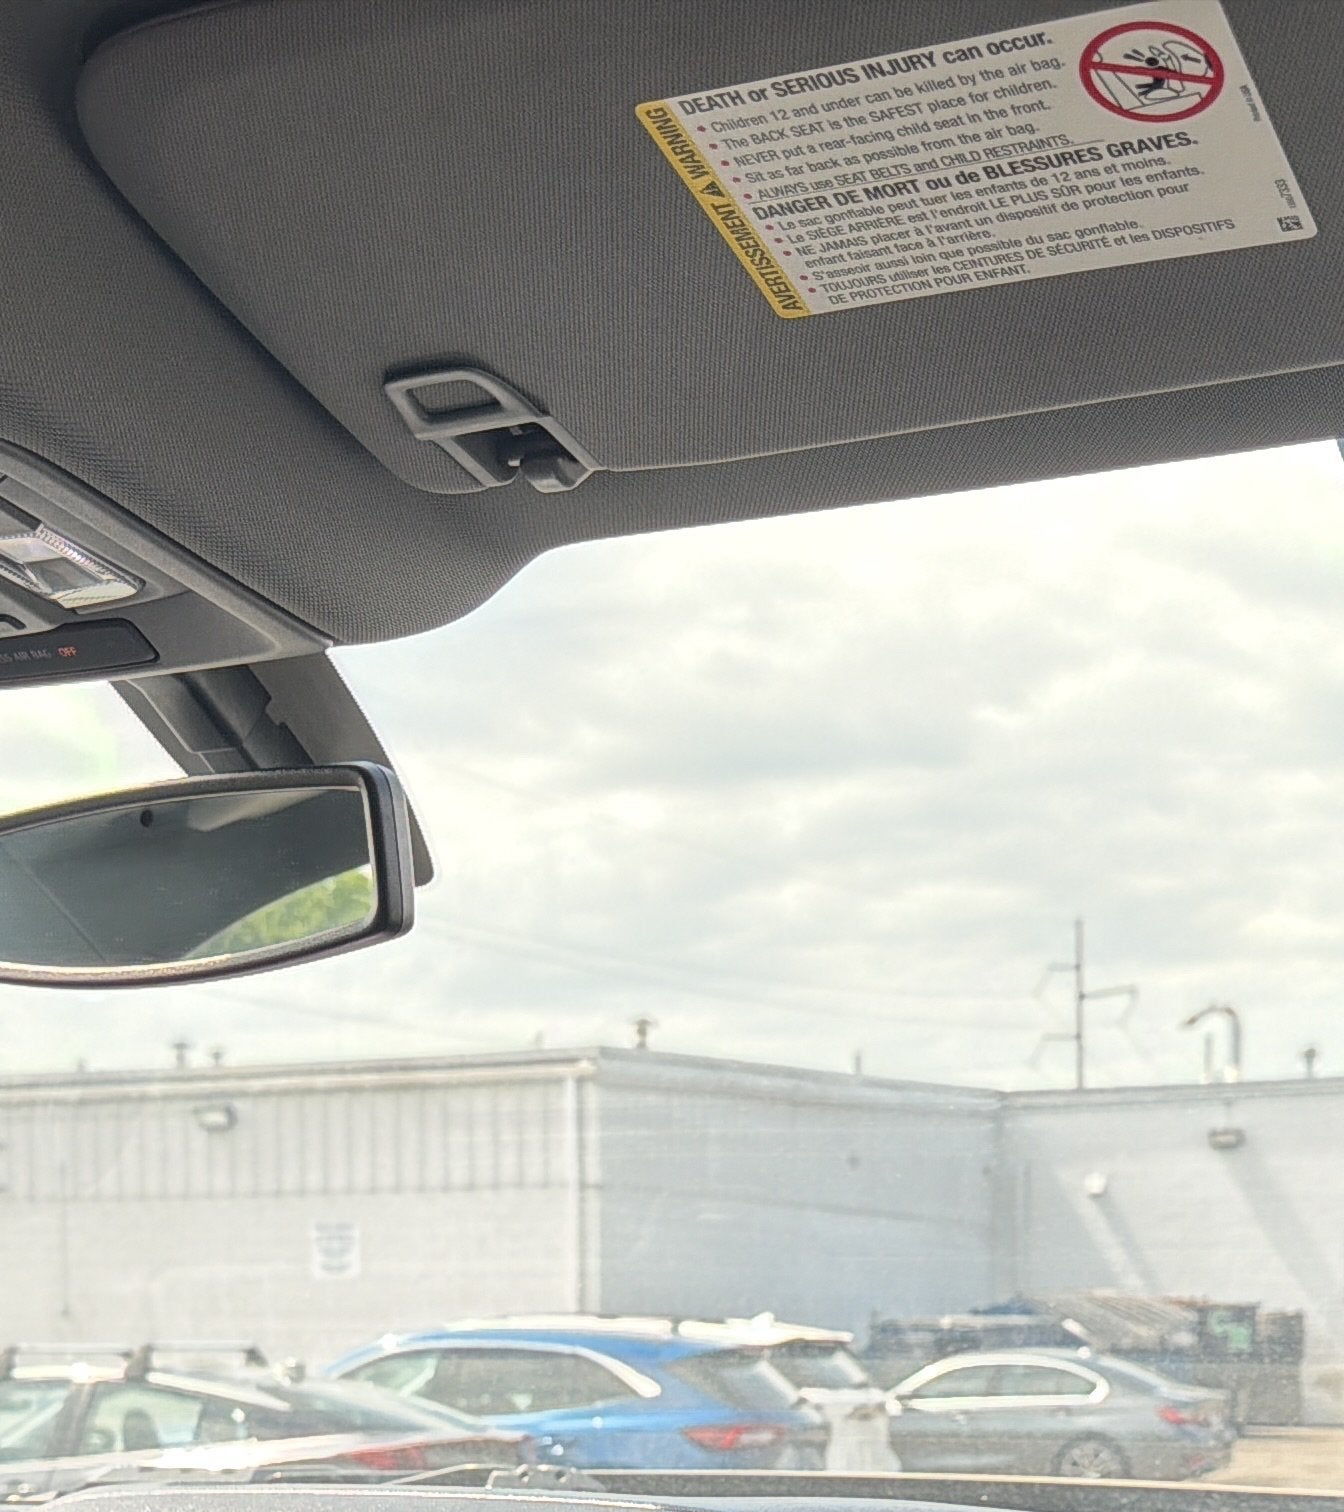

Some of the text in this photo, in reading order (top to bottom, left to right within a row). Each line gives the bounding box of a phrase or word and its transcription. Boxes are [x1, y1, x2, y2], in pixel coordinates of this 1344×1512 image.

[678, 32, 1052, 115] DEATH or SERIOUS INJURY can occur.
[710, 57, 1065, 132] Children 12 and under can be killed by the air bag.
[719, 80, 1056, 150] The BACK SEAT is the SAFEST place for children.
[733, 149, 781, 167] NEVER
[780, 144, 806, 160] put
[818, 130, 895, 151] rear-facing
[896, 120, 931, 137] child
[933, 114, 965, 130] seat
[965, 112, 982, 123] in
[982, 108, 1008, 120] the
[1010, 99, 1051, 115] front.
[744, 123, 1039, 183] Sit as far back as possible from the air bag.
[752, 131, 1197, 220] DANGER DE MORT ou de BLESSURES GRAVES.
[757, 134, 1075, 200] ALWAYS use SEAT BELTS and CHILD RESTRAINTS.
[645, 106, 803, 310] AVERTISSEMENT WARNING
[776, 221, 796, 231] Le
[797, 216, 822, 227] sac
[886, 198, 919, 214] peut
[919, 194, 947, 206] tuer
[949, 190, 973, 201] les
[975, 180, 1027, 196] enfants
[1029, 176, 1048, 187] de
[1051, 171, 1071, 183] 12
[1073, 167, 1101, 180] ans
[1103, 162, 1120, 174] et
[1120, 157, 1171, 171] moins.
[785, 166, 1204, 244] Le SIÈGE ARRIÈRE est l'endroit LE PLUS SÛR pour les enfants.
[794, 244, 817, 256] NE
[819, 235, 868, 253] JAMAIS
[869, 229, 910, 246] placer
[924, 218, 973, 234] l'avant
[973, 216, 993, 226] un
[995, 203, 1058, 222] dispositif
[1060, 201, 1079, 212] de
[1082, 189, 1154, 209] protection
[1156, 183, 1188, 198] pour
[804, 253, 847, 268] enfant
[846, 245, 893, 260] faisant
[893, 241, 924, 253] face
[819, 218, 1235, 293] TOUJOURS utiliser les CEINTURES DE SÉCURITÉ et les DISPOSITIFS
[827, 263, 1030, 305] DE PROTECTION POUR ENFANT.
[874, 255, 909, 270] aussi
[909, 252, 937, 264] loin
[938, 248, 964, 261] que
[966, 238, 1022, 257] possible
[1025, 234, 1044, 245] du
[1046, 231, 1072, 242] sac
[58, 646, 77, 657] OFF
